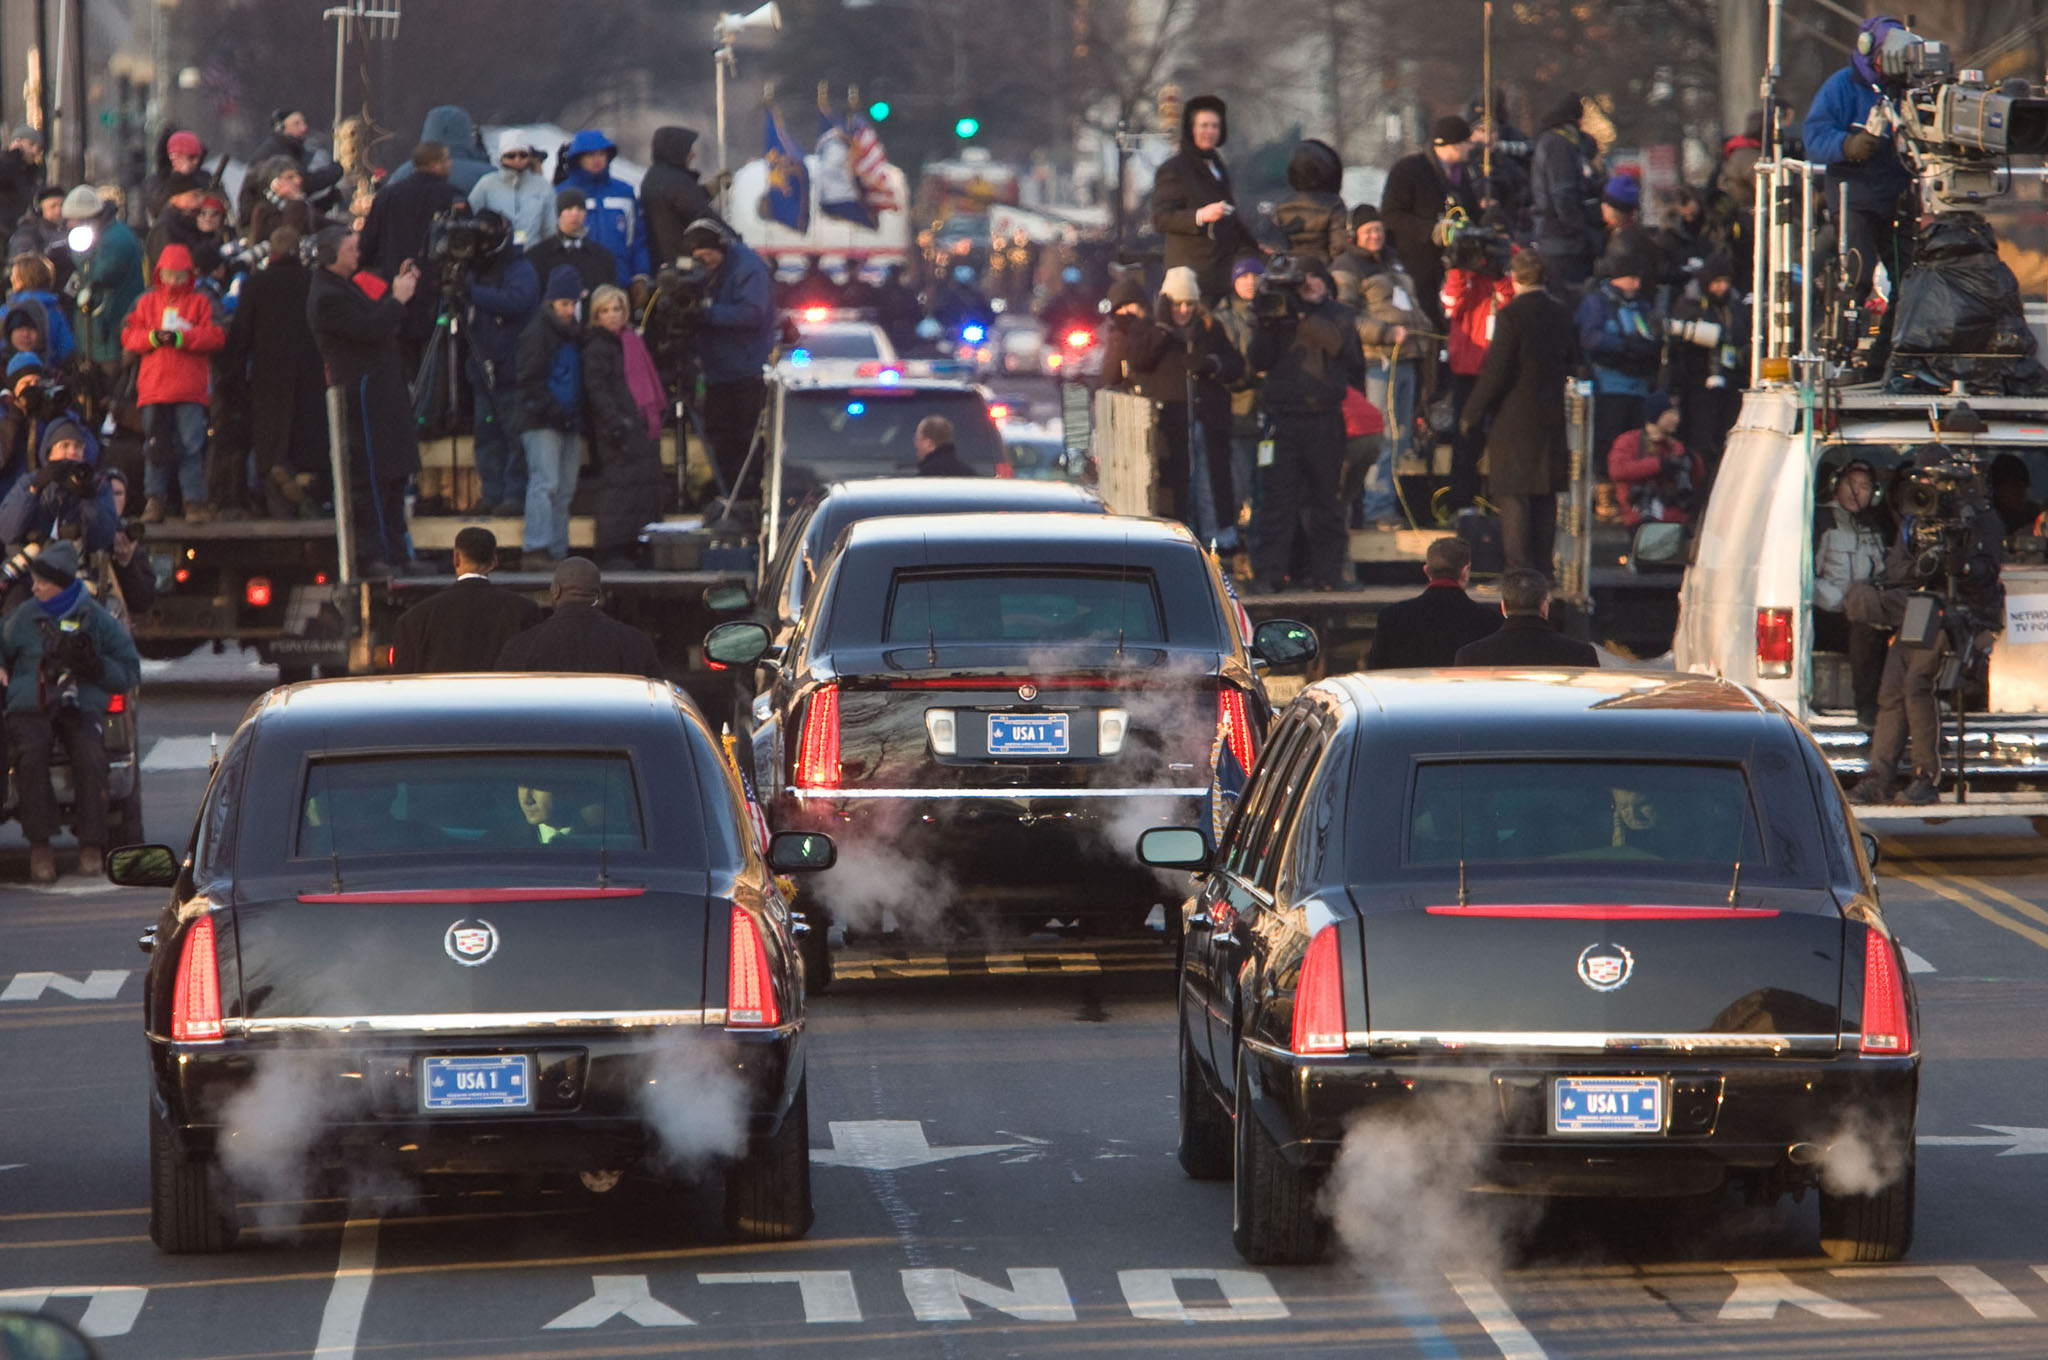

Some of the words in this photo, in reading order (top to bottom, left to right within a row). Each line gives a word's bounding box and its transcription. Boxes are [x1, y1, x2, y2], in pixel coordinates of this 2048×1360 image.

[2015, 622, 2029, 632] TV
[1012, 726, 1036, 741] USA
[1038, 726, 1045, 741] 1
[456, 1072, 487, 1090] USA
[489, 1071, 498, 1089] 1
[1586, 1093, 1617, 1114] USA
[1621, 1093, 1629, 1113] 1
[541, 1267, 1291, 1329] ONLY
